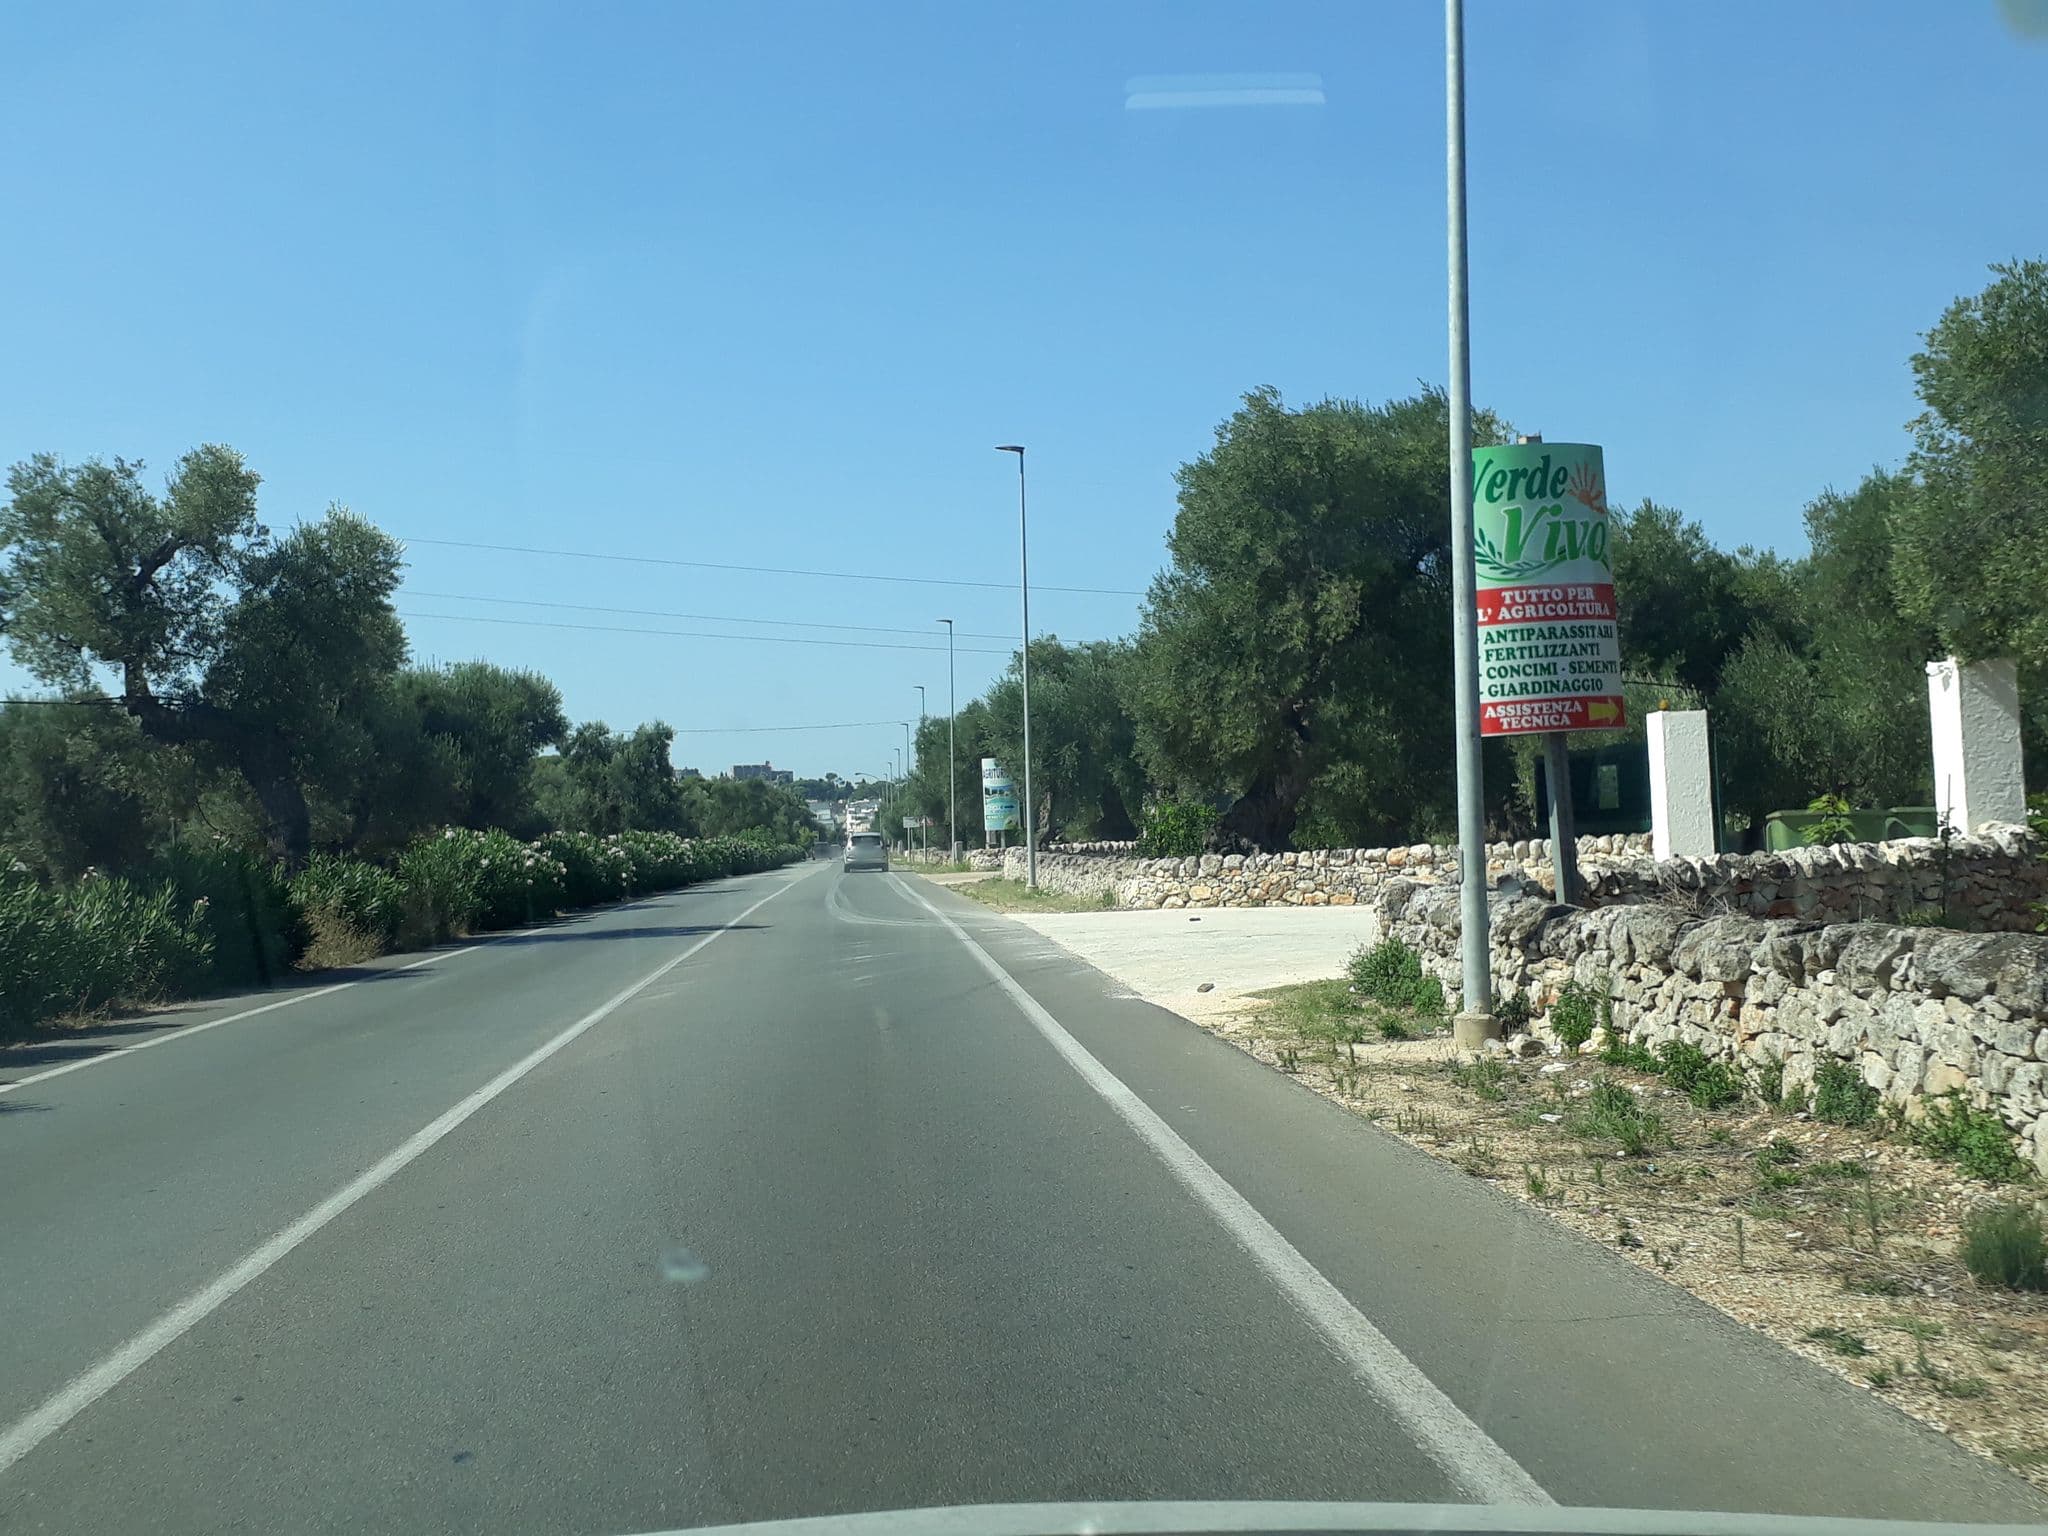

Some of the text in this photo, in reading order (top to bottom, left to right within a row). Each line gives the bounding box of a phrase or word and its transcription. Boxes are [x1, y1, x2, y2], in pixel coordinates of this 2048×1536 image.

[1473, 454, 1568, 503] Verde
[1503, 503, 1606, 563] Vivo
[1501, 586, 1594, 604] TUTTO PER
[1498, 602, 1610, 620] AGRICOLTURA
[1484, 624, 1613, 645] ANTIPARASSITARI
[1485, 643, 1600, 662] FERTILIZZANTI
[1486, 660, 1617, 679] CONCIMI SEMENTI
[1488, 678, 1603, 697] GIARDINAGGIO
[1485, 701, 1582, 719] ASSISTENZA
[1500, 713, 1571, 729] TECNICA
